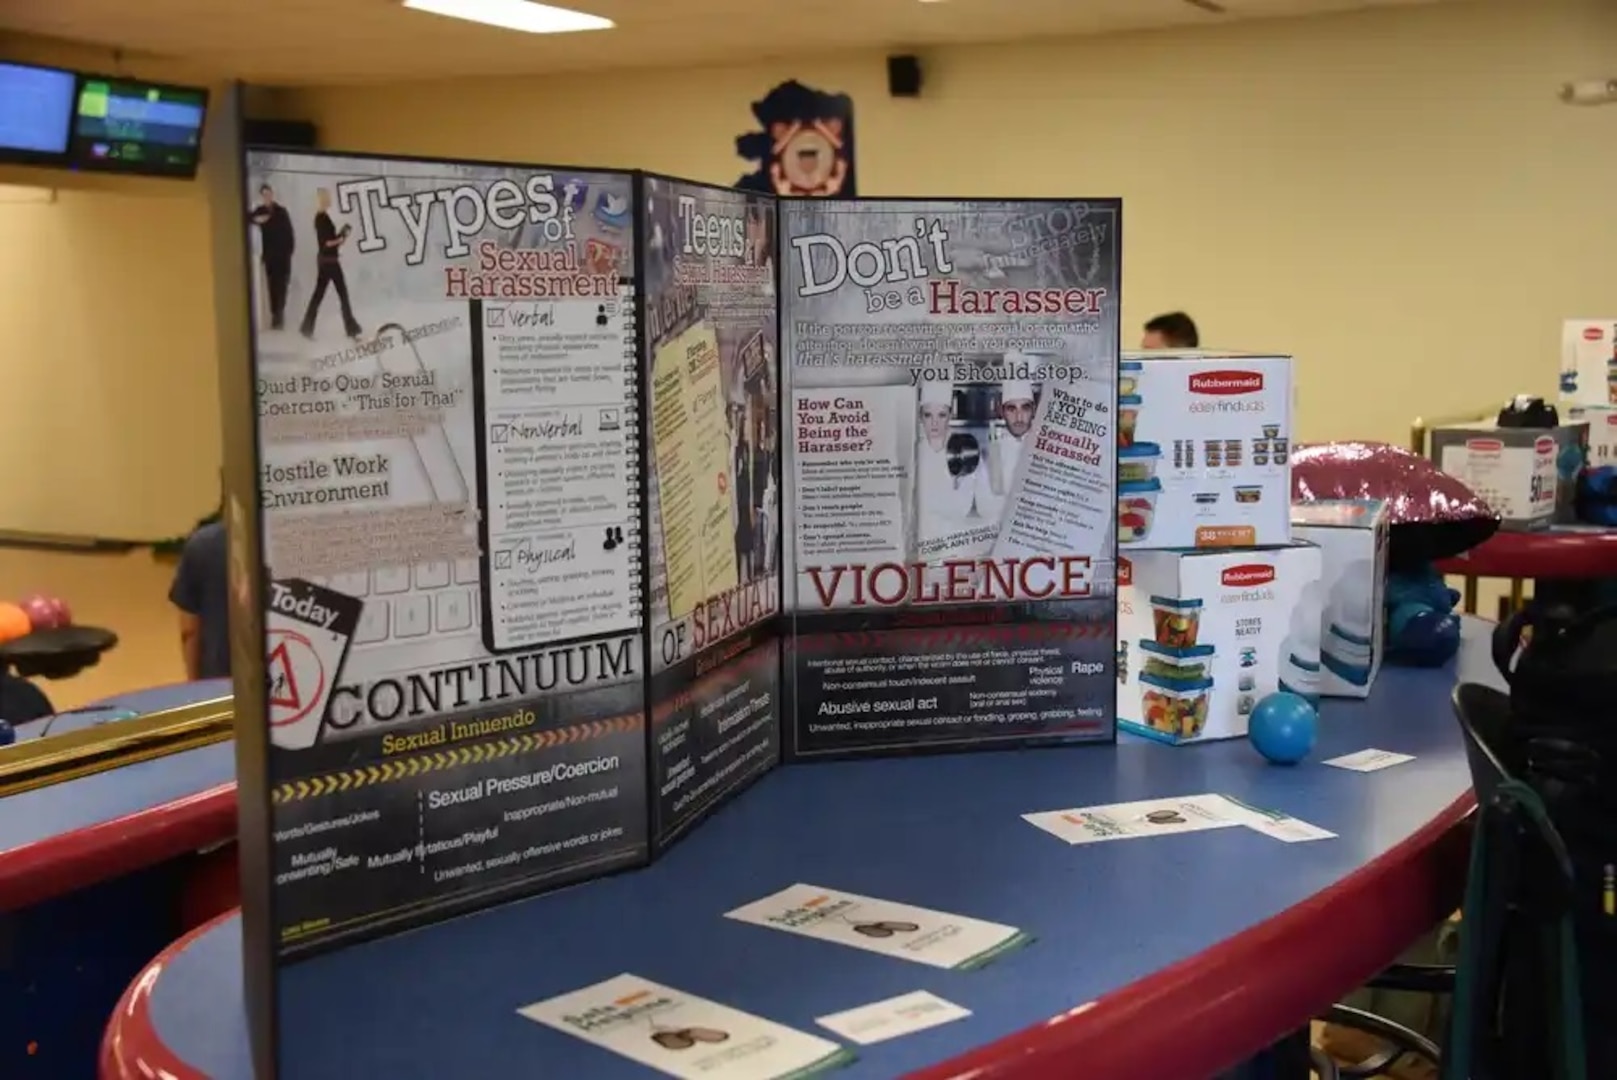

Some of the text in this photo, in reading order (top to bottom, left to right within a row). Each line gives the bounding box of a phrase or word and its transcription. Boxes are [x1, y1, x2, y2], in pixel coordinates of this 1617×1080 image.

[337, 174, 560, 265] Types
[543, 207, 576, 242] of
[678, 193, 745, 258] Teens
[479, 242, 578, 273] Sexual
[791, 217, 953, 298] Don't
[445, 268, 620, 298] Harassment
[865, 280, 1107, 315] be a Harasser
[508, 303, 555, 326] Verbal
[808, 321, 830, 336] the
[845, 350, 940, 368] harassment
[301, 376, 331, 393] Pro
[382, 371, 435, 388] Sexual
[909, 366, 950, 386] you
[956, 361, 1030, 382] should
[1192, 376, 1262, 389] Rubbermaid
[395, 393, 418, 407] for
[797, 397, 864, 411] How Can
[1052, 387, 1109, 414] What to do
[1057, 400, 1087, 419] YOU
[797, 411, 871, 425] You Avoid
[1043, 410, 1107, 438] ARE BEING
[798, 425, 869, 441] Being the
[1038, 424, 1101, 454] Sexually
[798, 439, 874, 454] Harasser?
[1034, 437, 1102, 467] Harassed
[333, 454, 389, 476] Work
[260, 480, 390, 509] Environment
[517, 539, 576, 573] Physical
[806, 555, 1093, 608] VIOLENCE
[1224, 568, 1273, 582] Rubbermaid
[271, 584, 341, 630] Today
[662, 620, 686, 665] OF
[693, 578, 776, 651] SEXUAL
[1028, 665, 1064, 676] Physical
[1071, 660, 1104, 675] Rape
[324, 638, 634, 731] CONTINUUM
[1028, 675, 1065, 686] violence
[817, 696, 938, 716] Abusive sexual act
[382, 709, 536, 755] Sexual Innuendo
[428, 780, 483, 810] Sexual
[486, 755, 620, 796] Pressure/Coercion
[563, 834, 590, 849] words
[590, 832, 600, 842] or
[600, 825, 623, 840] jokes
[291, 846, 338, 868] Mutually
[367, 847, 415, 869] Mutually
